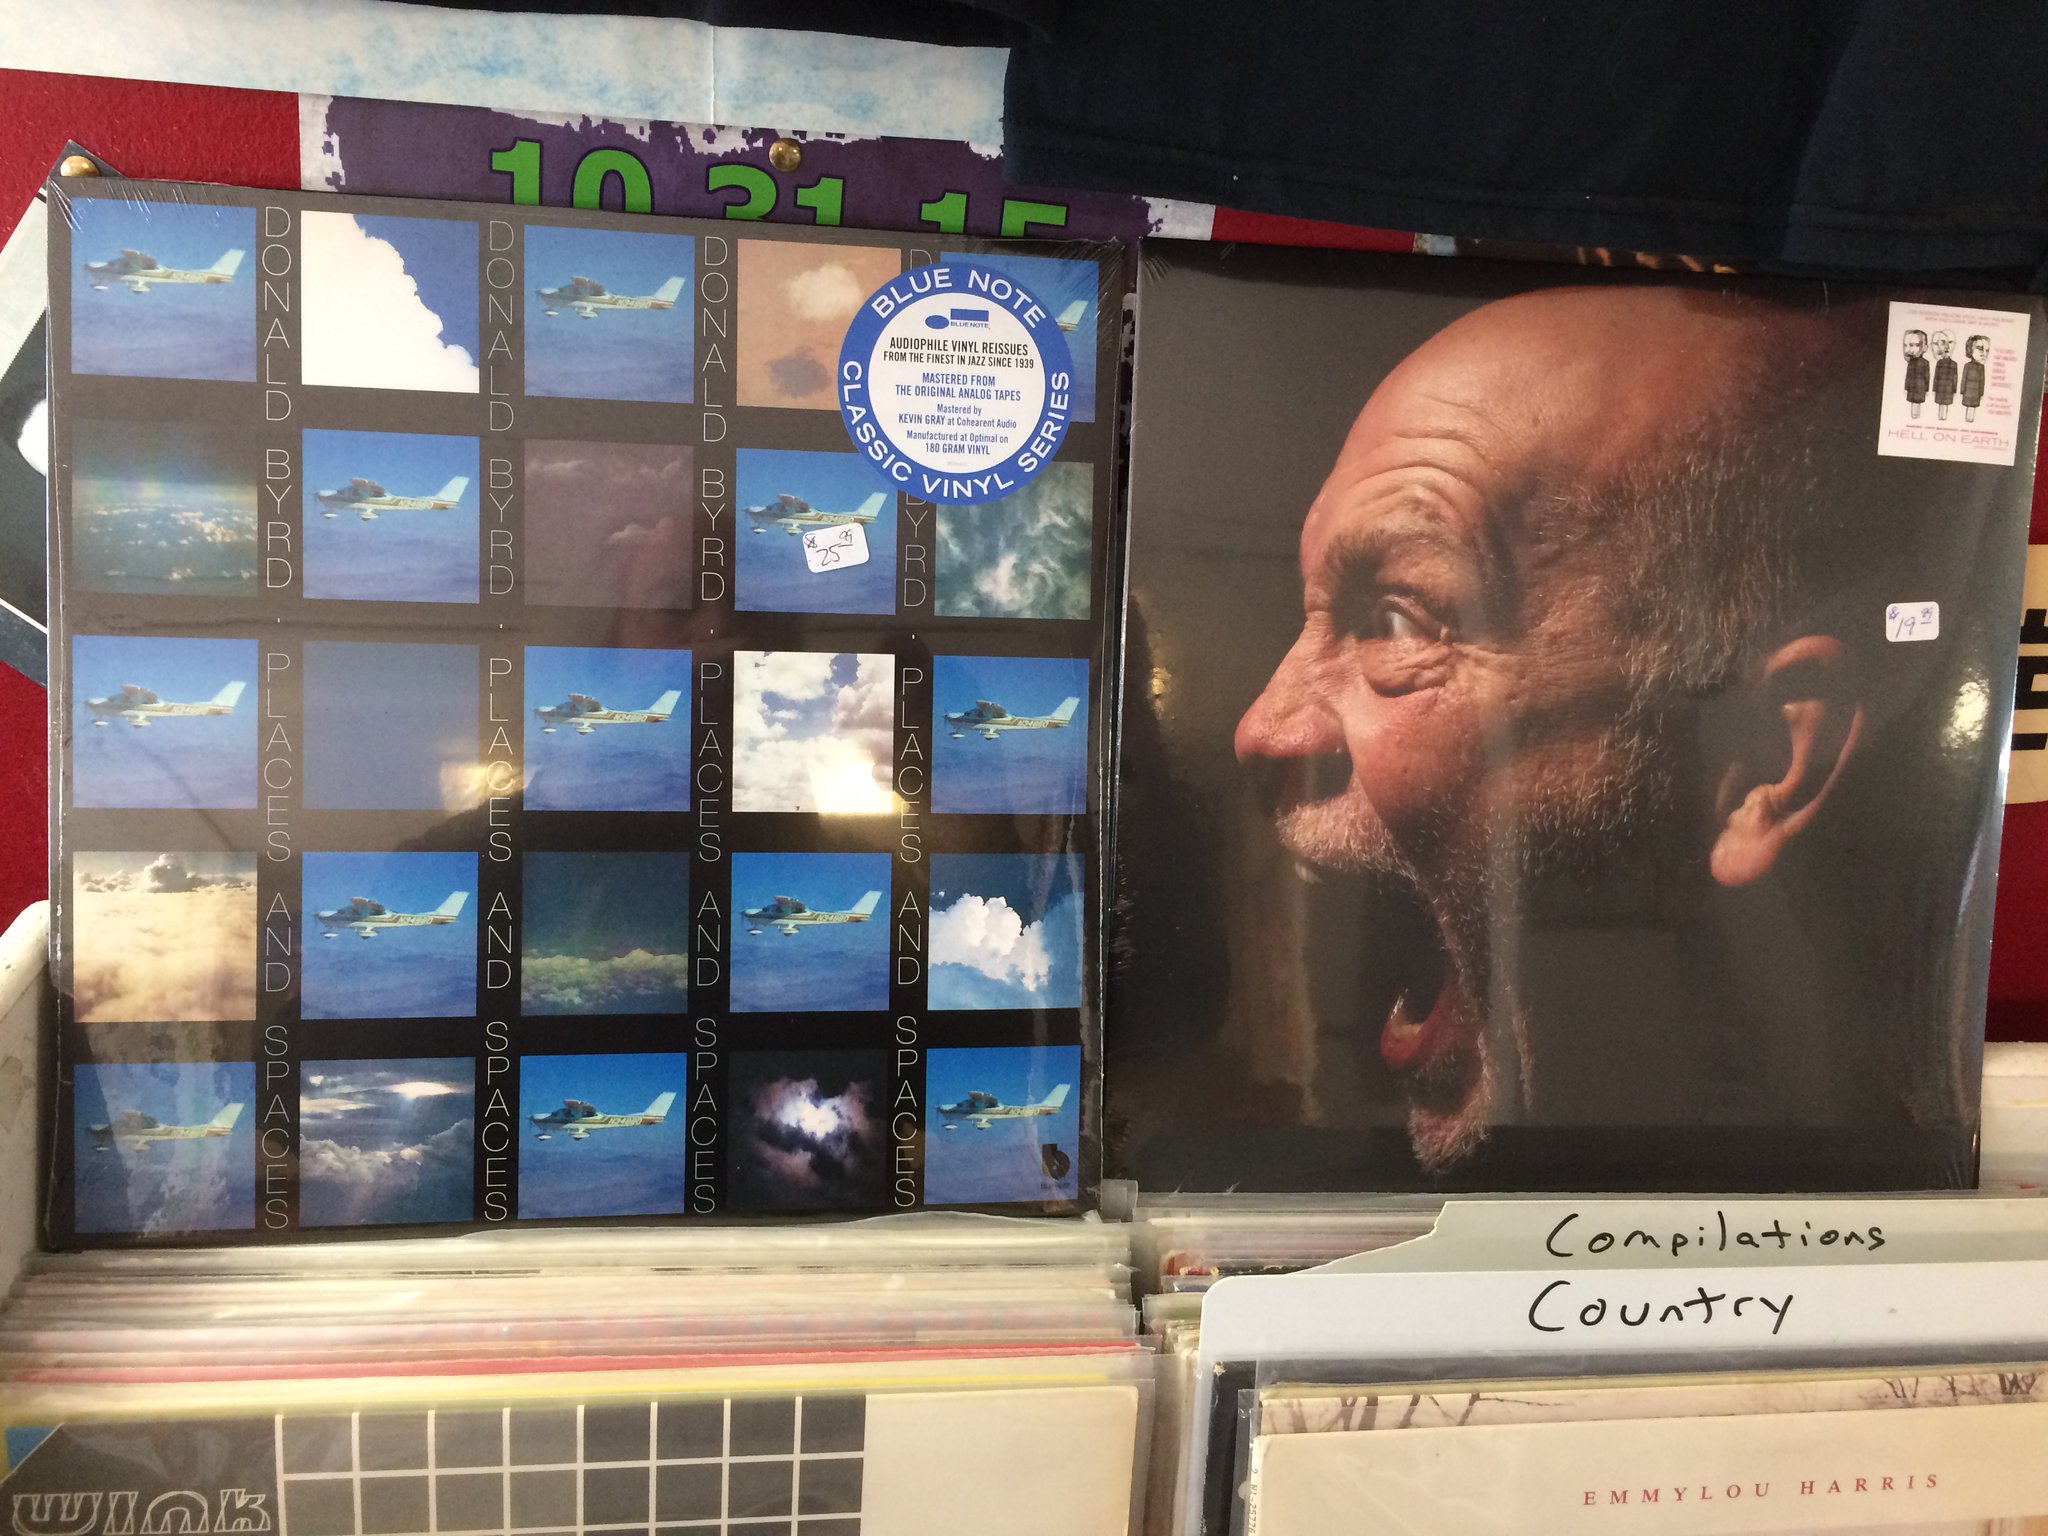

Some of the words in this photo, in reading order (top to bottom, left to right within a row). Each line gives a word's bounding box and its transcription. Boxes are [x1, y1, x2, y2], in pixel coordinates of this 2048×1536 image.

[491, 140, 652, 213] 10
[262, 207, 292, 422] DONALD
[486, 221, 515, 432] DONALD
[701, 236, 729, 443] DONALD
[871, 268, 953, 319] BLUE
[968, 269, 1047, 329] NOTE
[890, 336, 949, 352] AUDIOPHILE
[951, 339, 979, 354] VINYL
[981, 342, 1029, 356] REISSUES
[883, 350, 907, 362] FROM
[909, 352, 924, 363] THE
[926, 353, 955, 365] FINEST
[957, 354, 966, 366] IN
[967, 355, 986, 367] JAZZ
[988, 356, 1012, 368] SINCE
[1015, 358, 1034, 369] 1939
[895, 384, 912, 396] THE
[914, 385, 956, 399] ORIGINAL
[958, 387, 992, 400] ANALOG
[995, 389, 1021, 402] TAPES
[922, 372, 968, 386] MASTERED
[970, 374, 996, 387] FROM
[842, 360, 913, 482] CLASSIC
[921, 472, 1015, 499] VINYL
[1017, 371, 1070, 473] SERIES
[898, 413, 923, 424] KEVIN
[925, 414, 946, 425] GRAY
[947, 417, 955, 426] at
[956, 416, 995, 428] Cohearent
[997, 418, 1017, 429] Audio
[906, 429, 958, 442] Manufactured
[960, 432, 968, 442] at
[969, 432, 998, 444] Optimal
[999, 435, 1009, 444] on
[925, 442, 940, 453] 180
[942, 443, 966, 454] GRAM
[967, 444, 991, 456] VINYL
[936, 403, 971, 414] Mastered
[973, 405, 982, 416] by
[1887, 429, 1929, 441] HELL
[1933, 432, 1957, 444] ON
[1960, 434, 2010, 448] EARTH
[265, 449, 291, 589] BYRD
[489, 459, 514, 595] BYRD
[702, 469, 726, 602] BYRD
[264, 652, 292, 862] PLACES
[487, 658, 514, 862] PLACES
[696, 663, 723, 863] PLACES
[898, 667, 923, 864] PLACES
[265, 893, 291, 993] AND
[486, 891, 513, 990] AND
[696, 891, 722, 988] AND
[897, 891, 922, 986] AND
[263, 1025, 290, 1230] SPACES
[481, 1021, 509, 1223] SPACES
[690, 1018, 718, 1215] SPACES
[892, 1015, 919, 1209] SPACES
[1545, 1210, 1887, 1258] Compilations
[1528, 1279, 1794, 1335] Country
[1583, 1483, 1770, 1506] EMMYLOU
[1799, 1474, 1938, 1496] HARRIS
